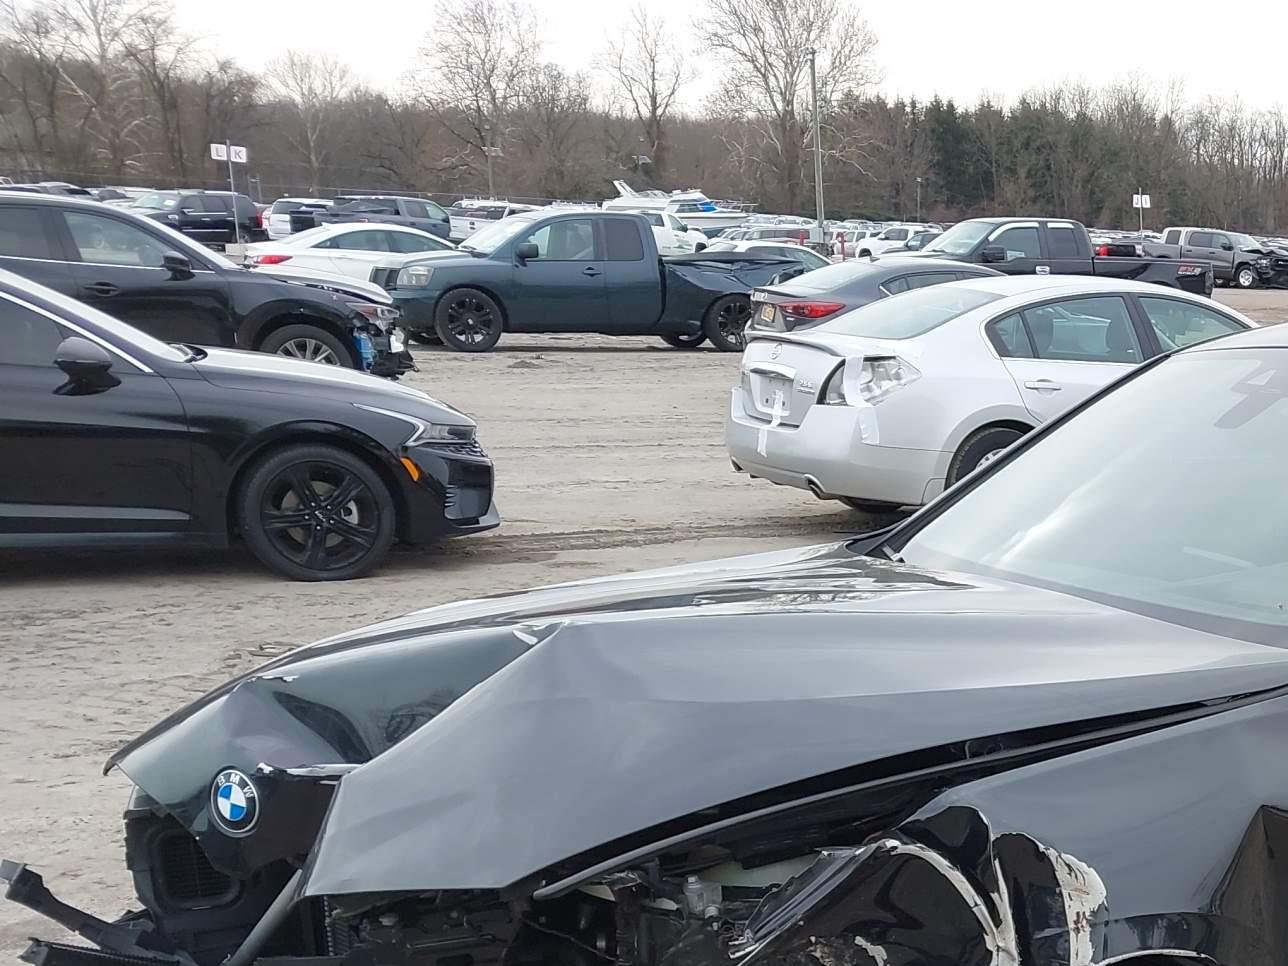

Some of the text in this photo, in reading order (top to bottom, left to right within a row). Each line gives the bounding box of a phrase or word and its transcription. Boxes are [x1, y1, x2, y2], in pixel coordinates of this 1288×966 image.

[216, 147, 223, 158] L
[235, 150, 242, 160] K
[217, 772, 255, 798] BMW
